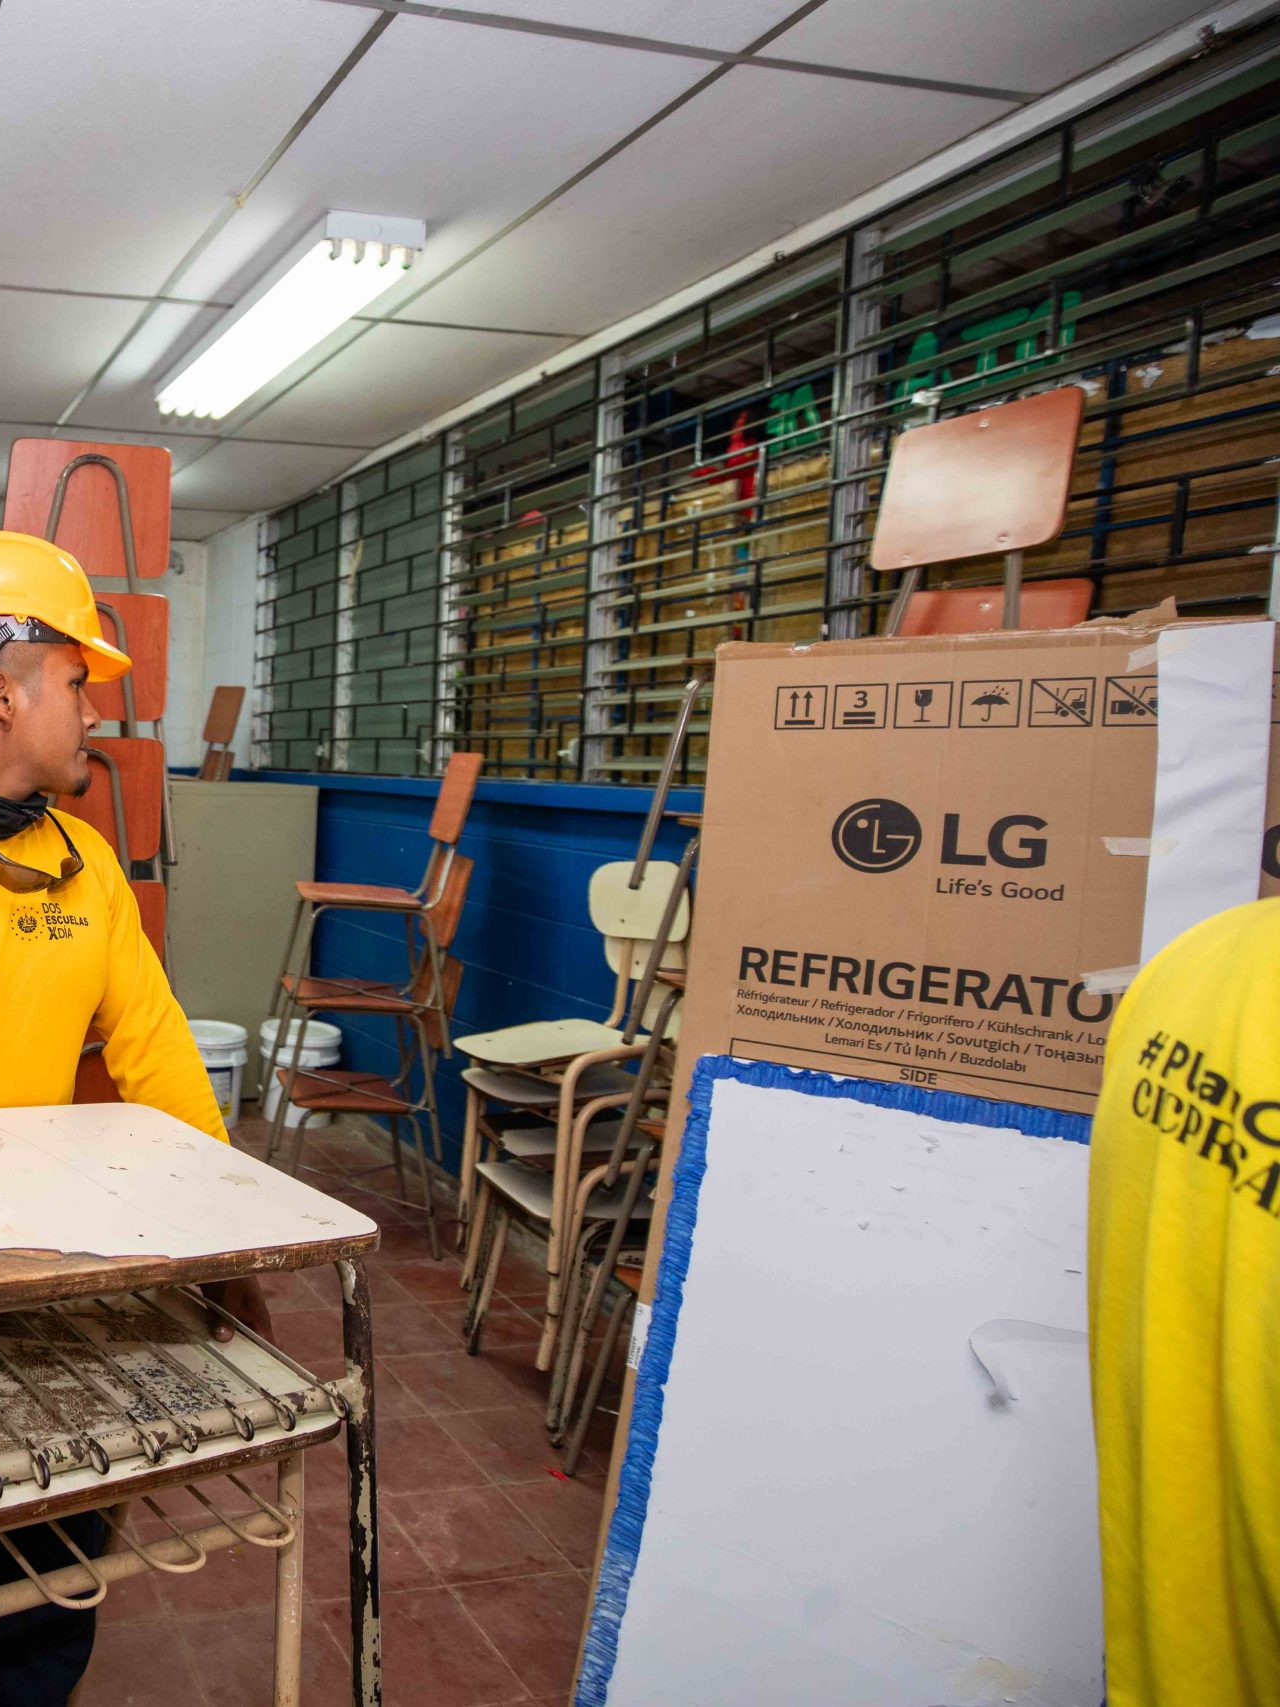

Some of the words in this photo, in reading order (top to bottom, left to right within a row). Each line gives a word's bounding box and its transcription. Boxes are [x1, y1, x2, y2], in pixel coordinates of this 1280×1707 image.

[853, 690, 869, 709] 3
[940, 813, 1049, 869] LG
[935, 877, 993, 898] Life's
[1001, 881, 1066, 902] Good
[41, 903, 61, 914] DOS
[45, 915, 89, 926] ESCUELAS
[738, 946, 1125, 1023] REFRIGERATO
[736, 988, 811, 1009] Réfrigérateur
[820, 999, 896, 1019] Refrigerador
[907, 1009, 975, 1030] Frigorifero
[987, 1019, 1074, 1044] Kühlschrank
[736, 1004, 826, 1028] Холодильник
[835, 1016, 935, 1043] Холодильник
[946, 1032, 1021, 1056] Sovutgich
[824, 1033, 865, 1050] Lemari
[867, 1039, 883, 1051] Es
[913, 1045, 947, 1062] lạnh
[899, 1068, 938, 1086] SIDE
